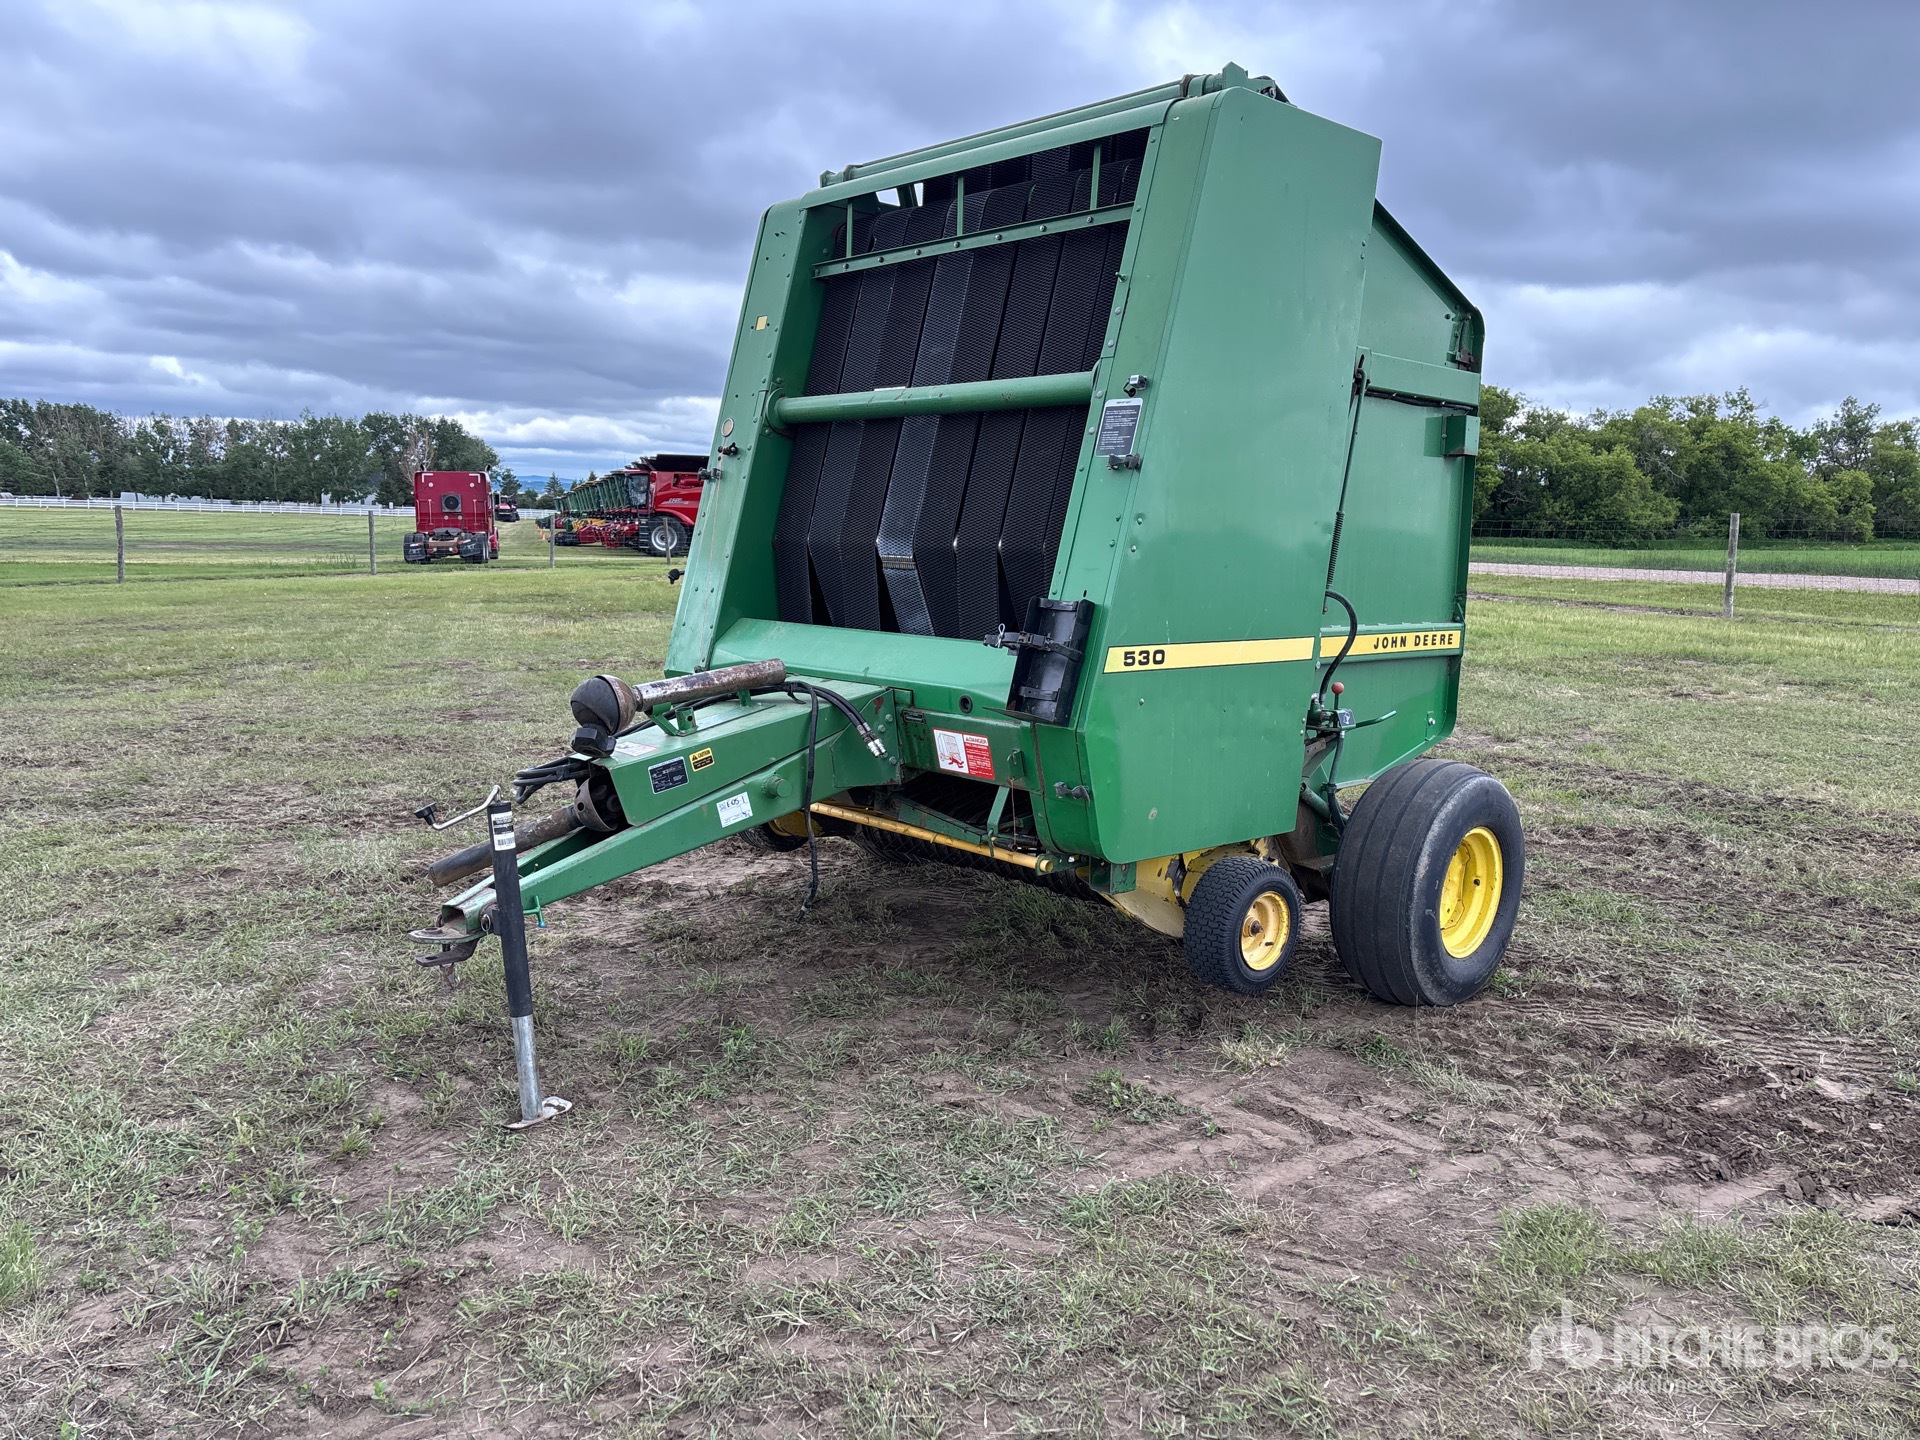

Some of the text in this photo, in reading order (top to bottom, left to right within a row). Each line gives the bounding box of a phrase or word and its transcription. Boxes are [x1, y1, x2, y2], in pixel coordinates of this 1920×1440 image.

[1373, 633, 1455, 650] JOHN DEERE
[1123, 649, 1166, 667] 530
